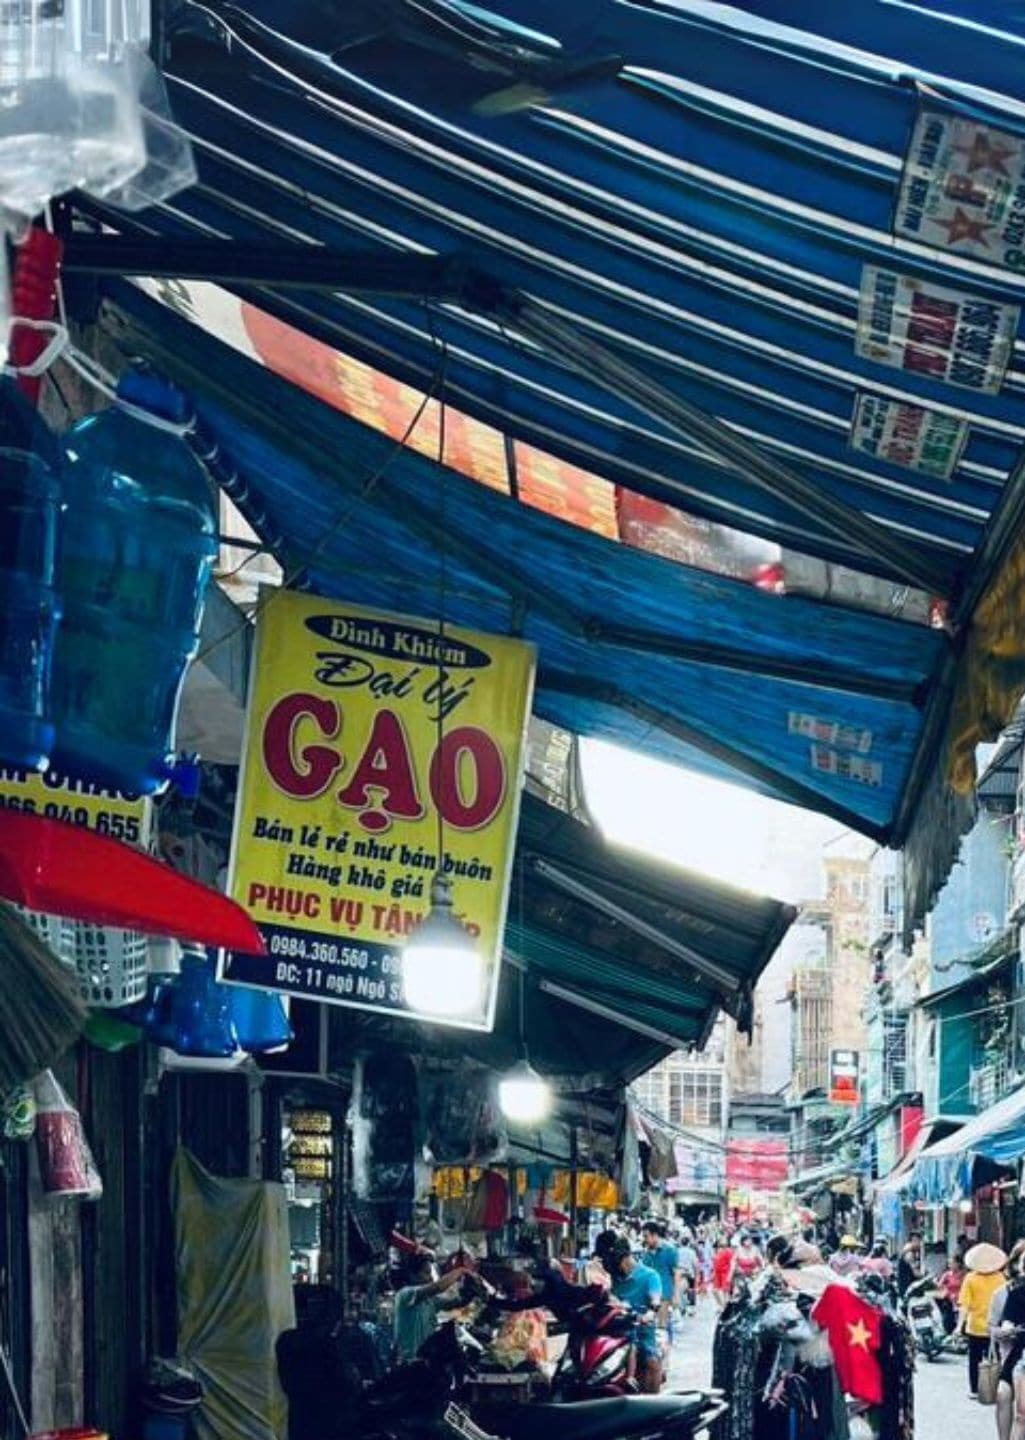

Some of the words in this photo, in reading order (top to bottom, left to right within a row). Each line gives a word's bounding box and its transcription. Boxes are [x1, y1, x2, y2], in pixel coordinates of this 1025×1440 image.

[314, 651, 421, 699] Đại
[262, 692, 507, 832] GẠO
[253, 816, 294, 843] Bán
[353, 838, 397, 862] như
[400, 844, 436, 870] bán
[443, 852, 492, 881] buôn
[287, 853, 342, 887] Hàng
[347, 864, 386, 890] khô
[390, 873, 424, 898] giá
[248, 881, 321, 921] PHỤC
[329, 896, 364, 931] VỤ
[306, 967, 322, 987] 11
